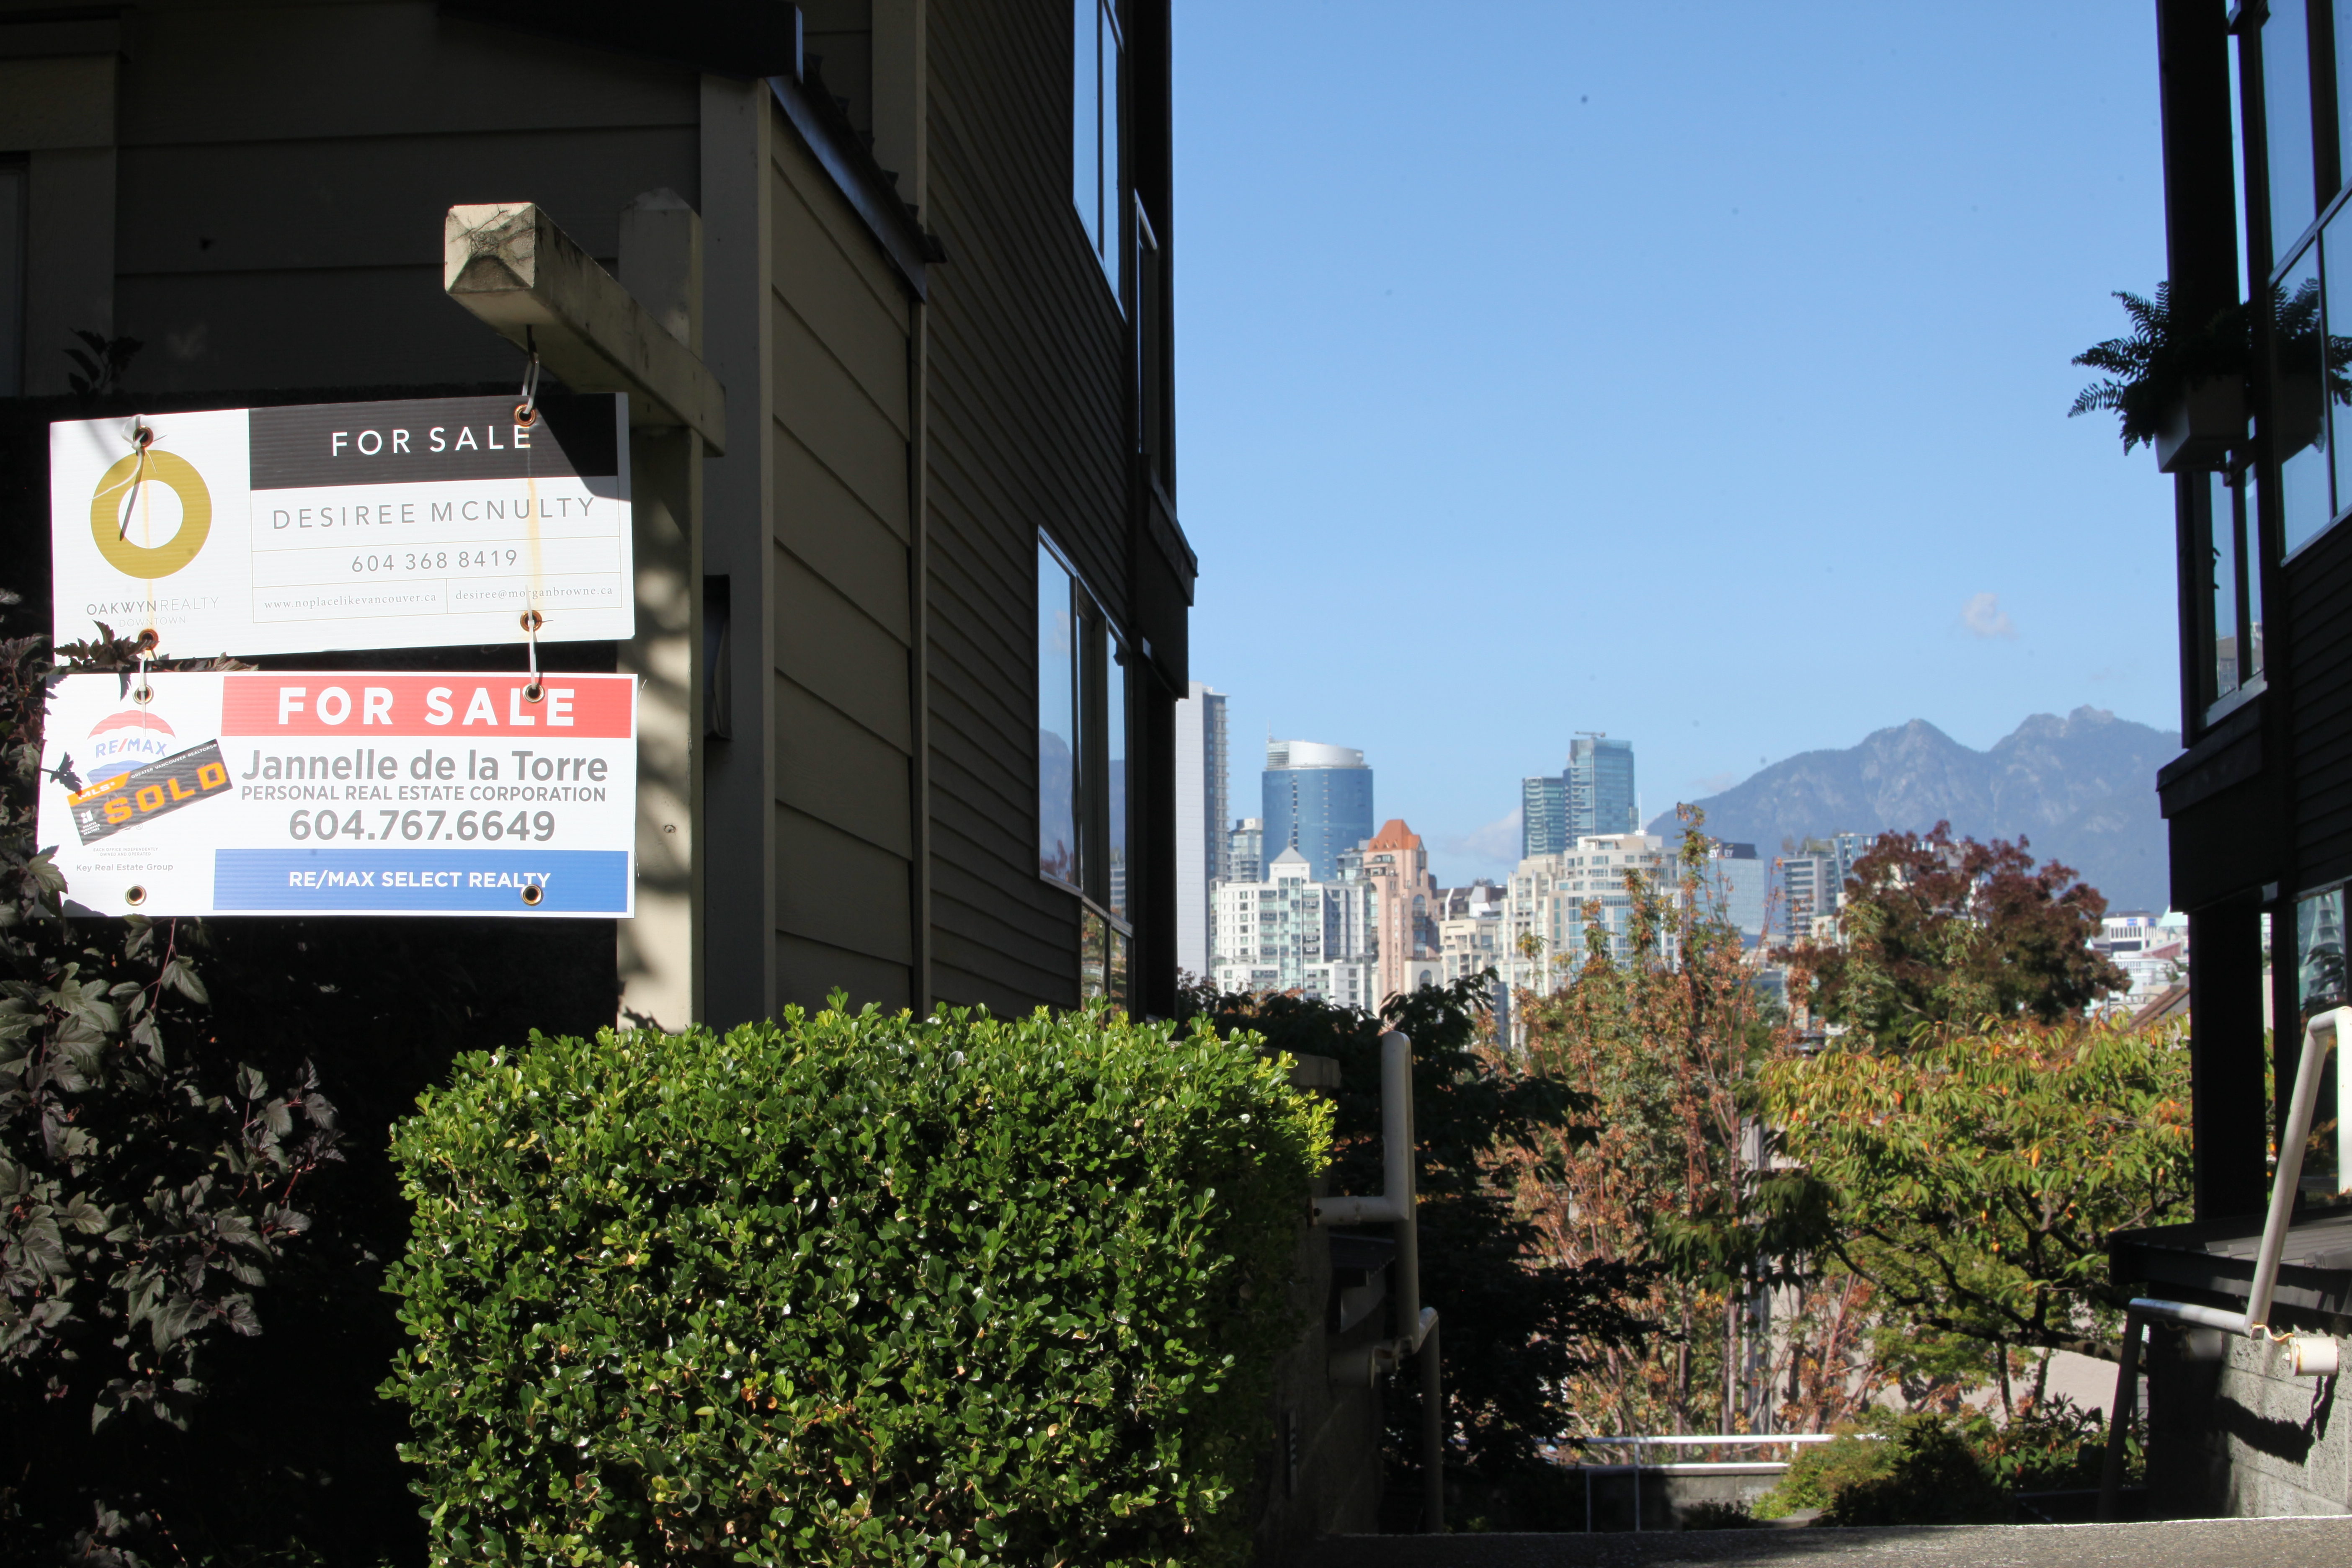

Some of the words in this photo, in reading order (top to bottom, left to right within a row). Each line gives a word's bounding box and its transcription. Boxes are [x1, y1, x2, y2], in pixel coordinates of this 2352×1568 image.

[332, 429, 410, 456] FOR
[430, 425, 531, 452] SALE
[273, 504, 415, 529] DESIREE
[432, 497, 594, 522] MCNULTY
[352, 554, 395, 572] 604
[405, 552, 448, 570] 368
[458, 549, 517, 567] 8419
[264, 594, 437, 609] www.noplacelikevancouver.ca
[119, 616, 186, 627] DOWNTOWN
[278, 686, 394, 725] FOR
[424, 686, 575, 726] SALE
[95, 738, 167, 758] RE/MAX
[131, 768, 154, 779] GREATER
[155, 755, 186, 769] VANCOUVER
[241, 748, 398, 780] Jannelle
[410, 748, 456, 780] de
[468, 749, 498, 780] la
[511, 750, 608, 782] Torre
[103, 762, 227, 824] SOLD
[242, 785, 340, 800] PERSONAL
[346, 785, 393, 800] REAL
[399, 785, 464, 801] ESTATE
[470, 786, 606, 802] CORPORATION
[289, 809, 555, 842] 604.767.6649
[76, 864, 93, 872] Key
[289, 870, 374, 889] RE/MAX
[382, 872, 462, 887] SELECT
[469, 872, 551, 888] REALTY
